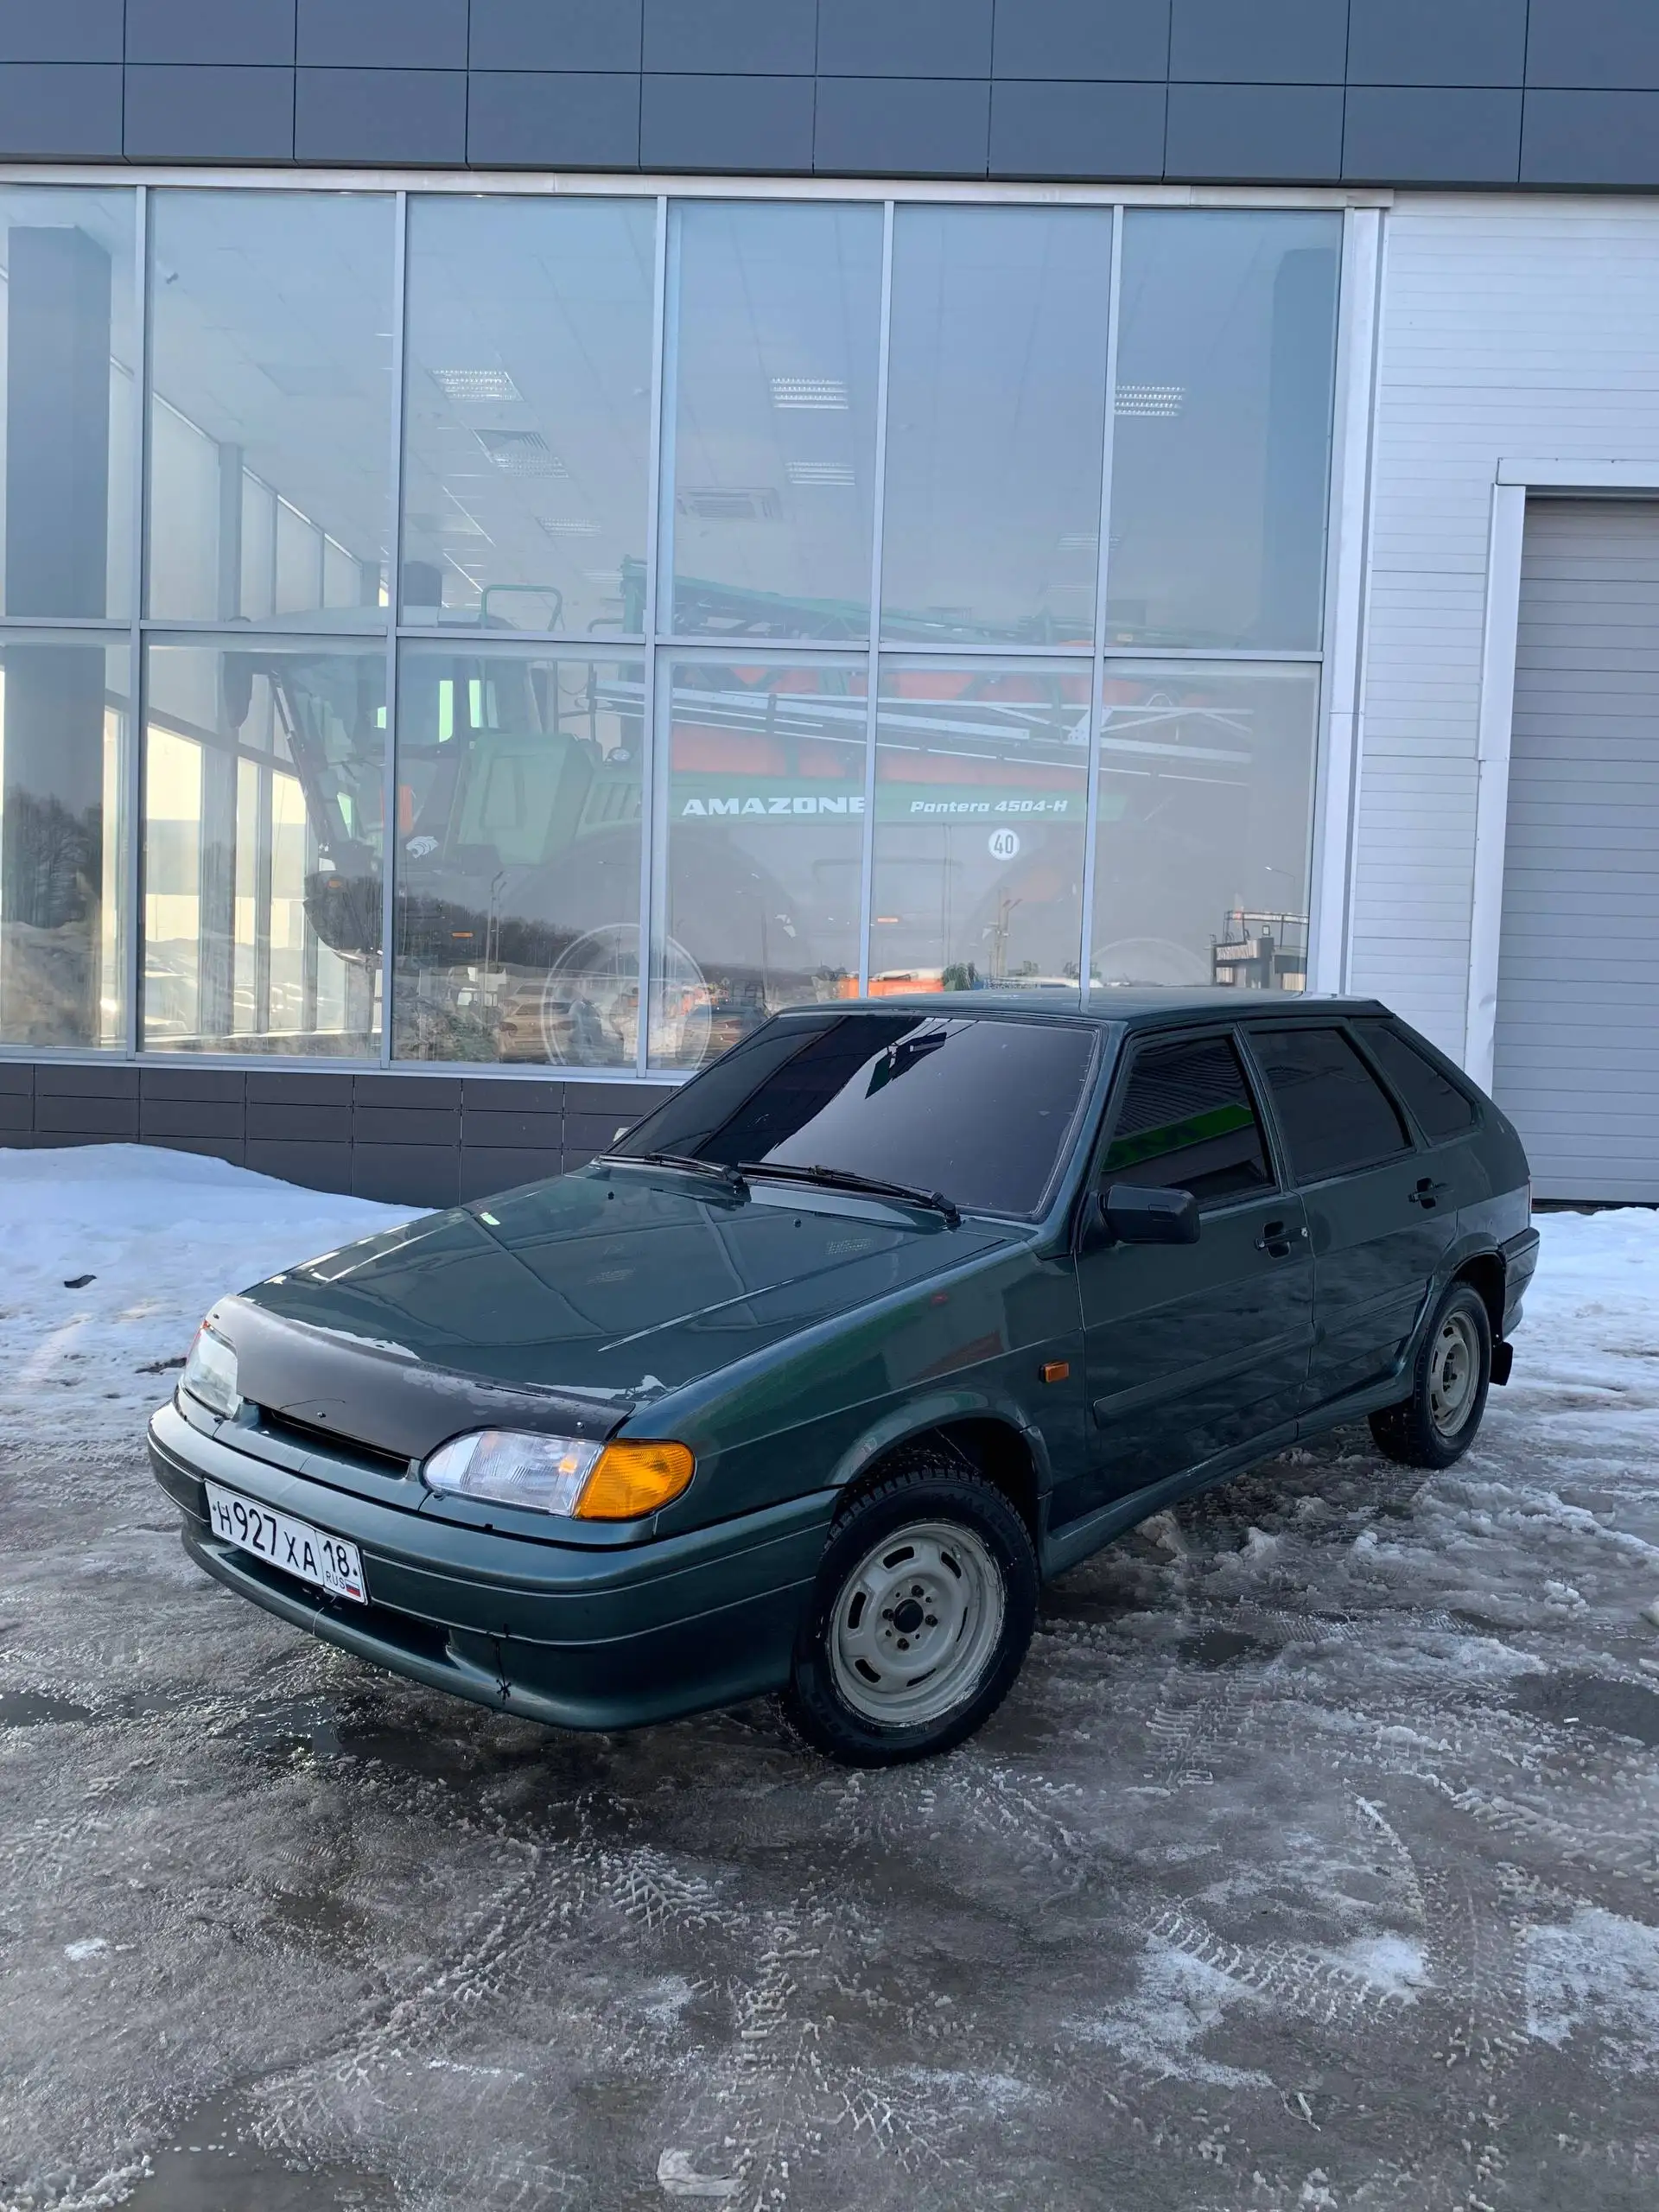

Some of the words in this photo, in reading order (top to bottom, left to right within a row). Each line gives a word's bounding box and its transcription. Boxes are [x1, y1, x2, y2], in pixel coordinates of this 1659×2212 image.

[682, 797, 865, 816] AMAZONE
[910, 801, 990, 813] Pantera
[995, 799, 1069, 812] 4504-H
[994, 834, 1014, 854] 40
[322, 1539, 350, 1578] 18
[325, 1570, 346, 1590] RUS
